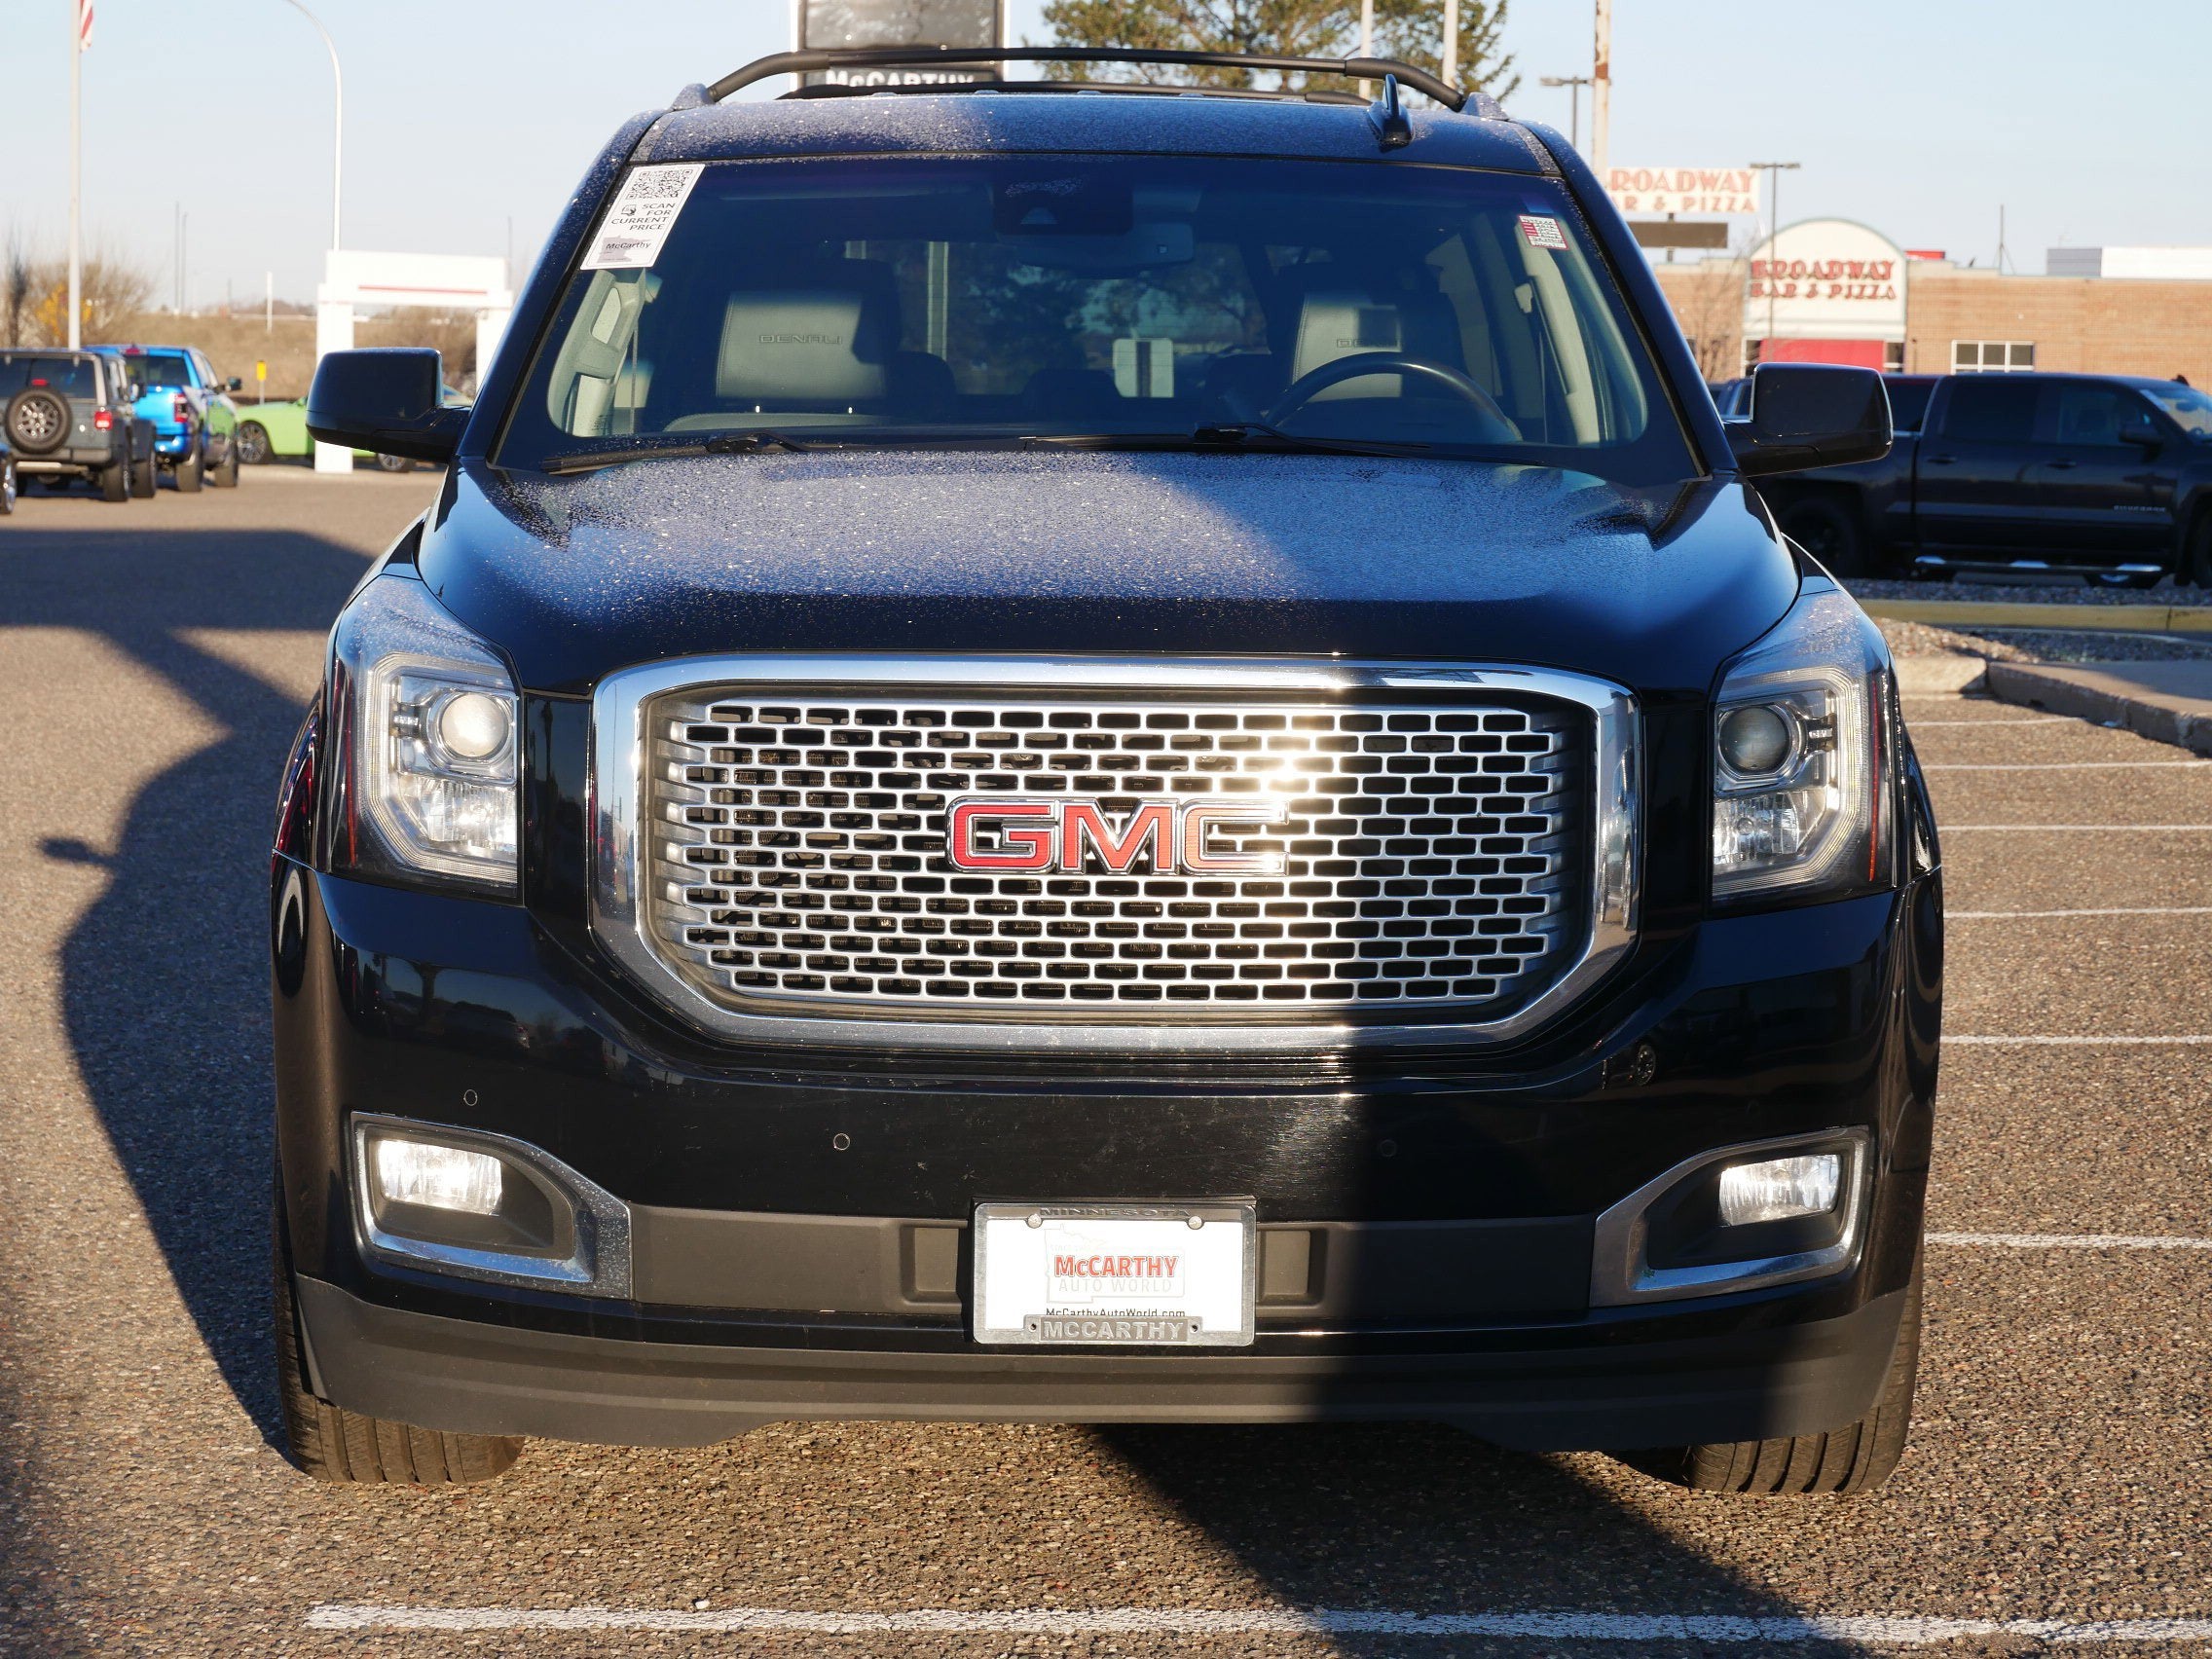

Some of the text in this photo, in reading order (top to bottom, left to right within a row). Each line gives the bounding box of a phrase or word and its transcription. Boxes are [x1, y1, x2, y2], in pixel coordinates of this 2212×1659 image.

[1610, 168, 1756, 193] ROADWAY
[1680, 197, 1755, 212] PIZZA
[611, 216, 669, 225] CURRENT
[1751, 260, 1895, 280] BROADWAY
[1751, 282, 1797, 298] BAR
[1827, 283, 1898, 300] PIZZA
[758, 334, 843, 345] DENALI
[945, 795, 1290, 876] GMC
[1039, 1206, 1193, 1217] MINNESOTA
[1054, 1255, 1179, 1277] McCARTHY
[1058, 1278, 1172, 1292] AUTO WORLD
[1043, 1320, 1184, 1340] MCCARTHY
